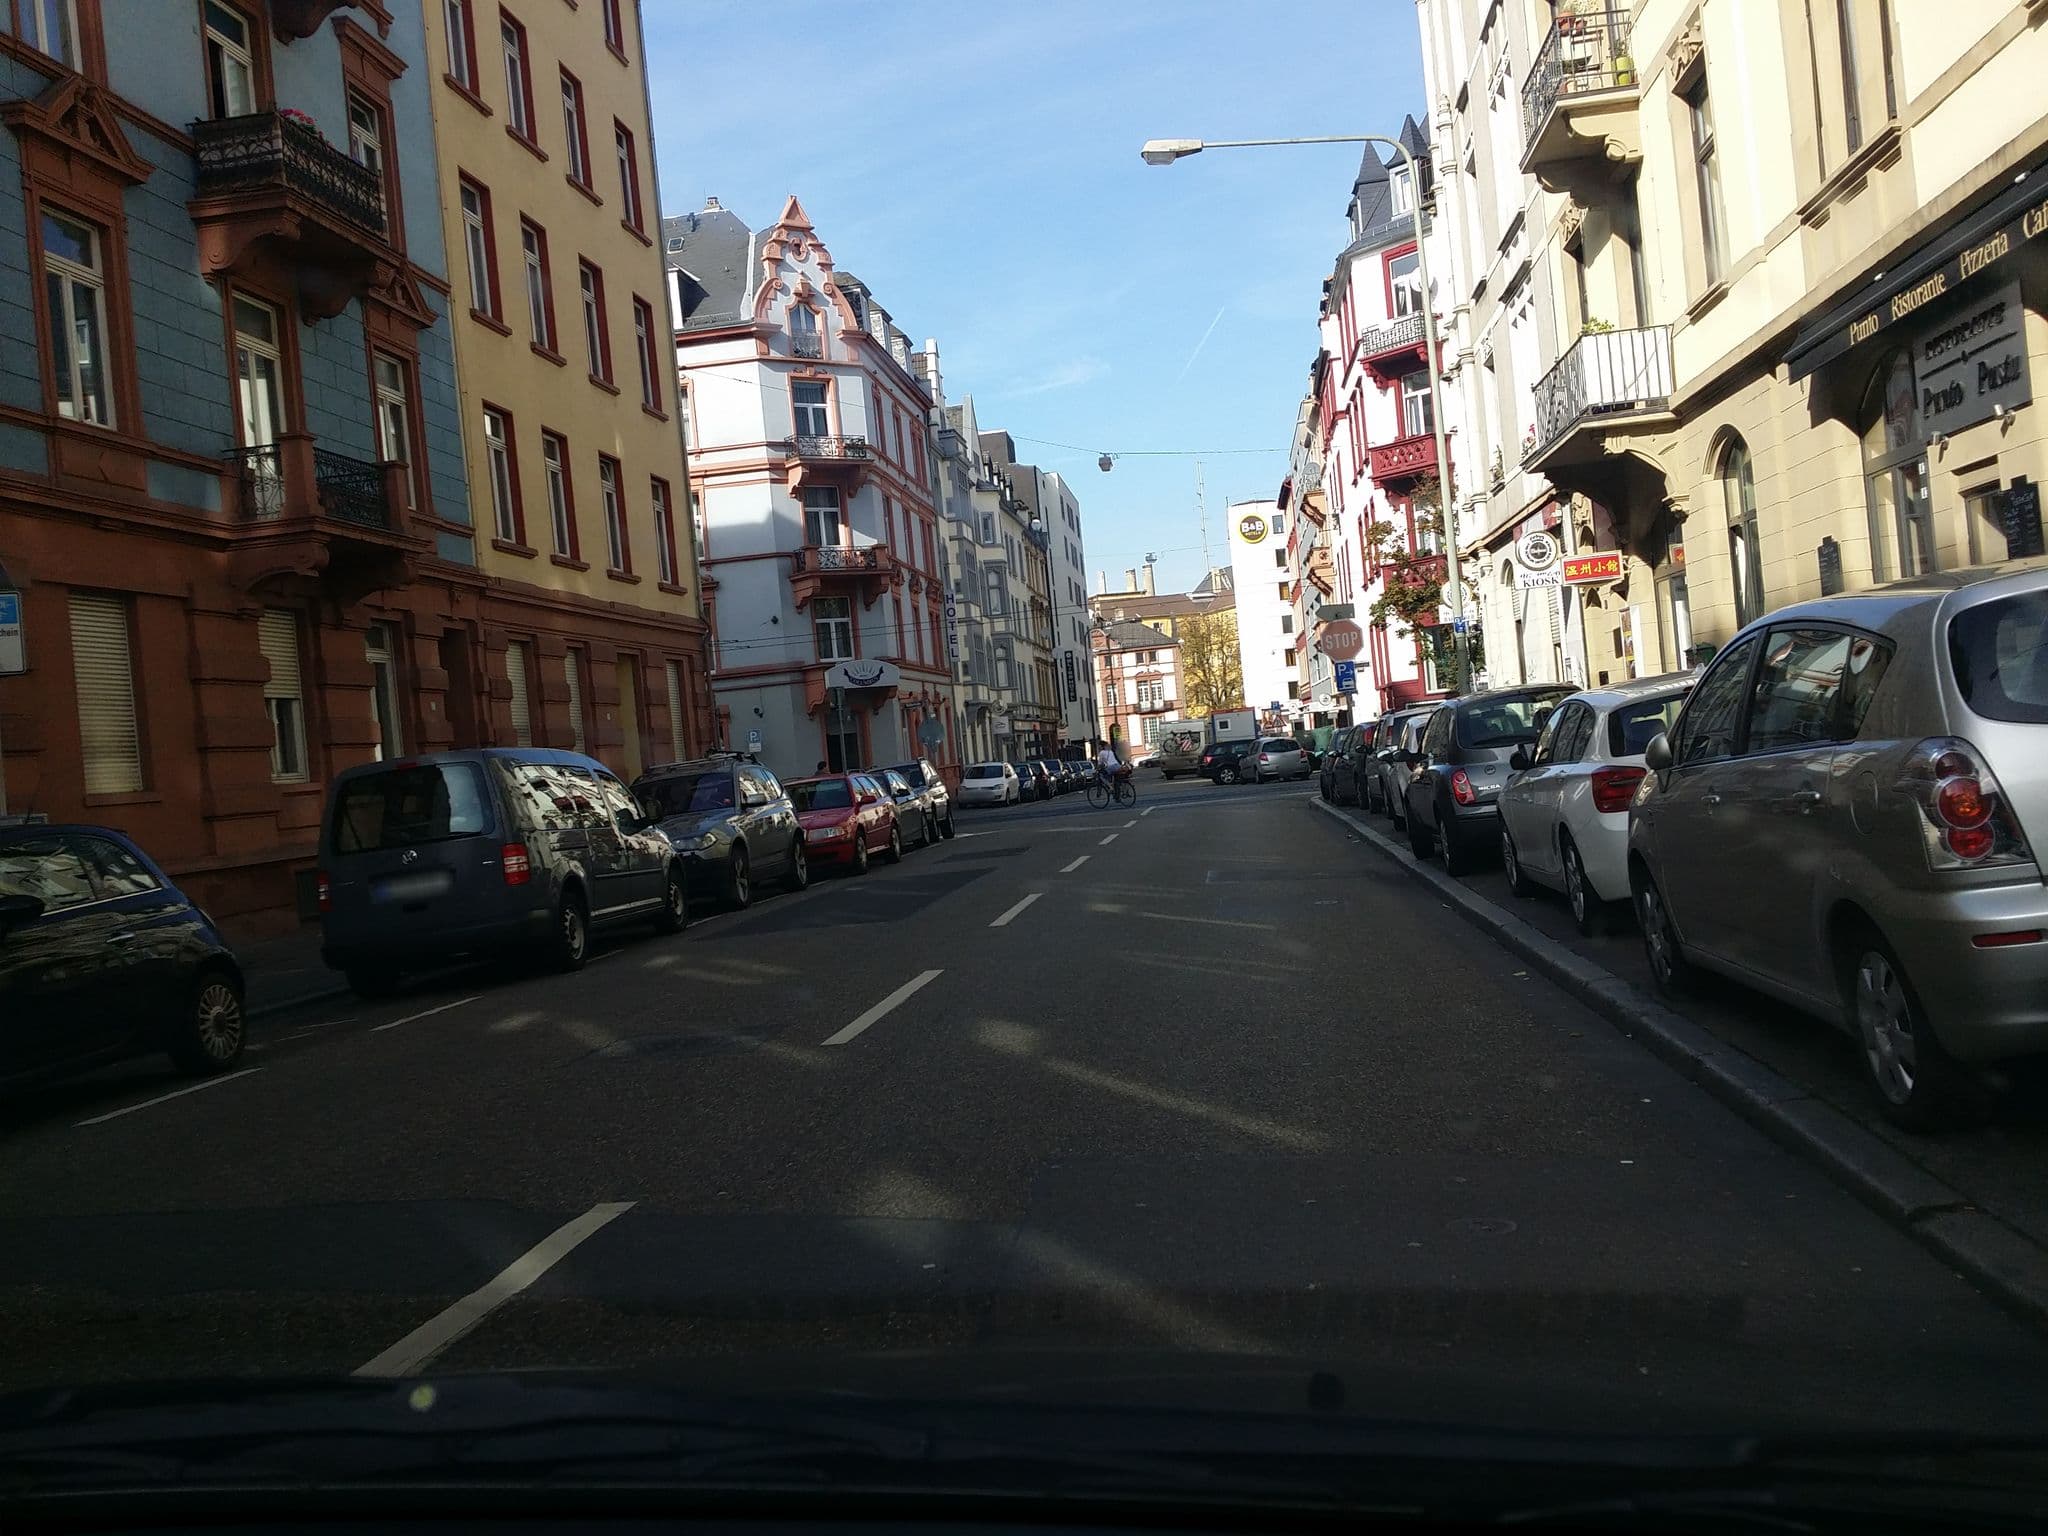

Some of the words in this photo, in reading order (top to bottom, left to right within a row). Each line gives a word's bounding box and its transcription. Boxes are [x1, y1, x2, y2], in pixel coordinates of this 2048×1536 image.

[1850, 312, 1879, 346] Punto
[1891, 273, 1947, 322] Ristorante
[1960, 232, 2009, 281] Pizzeria
[1923, 379, 1964, 420] Punto
[1523, 577, 1559, 588] KIOSK
[945, 593, 959, 658] HOTEL
[1325, 632, 1358, 650] STOP
[1337, 664, 1347, 677] P
